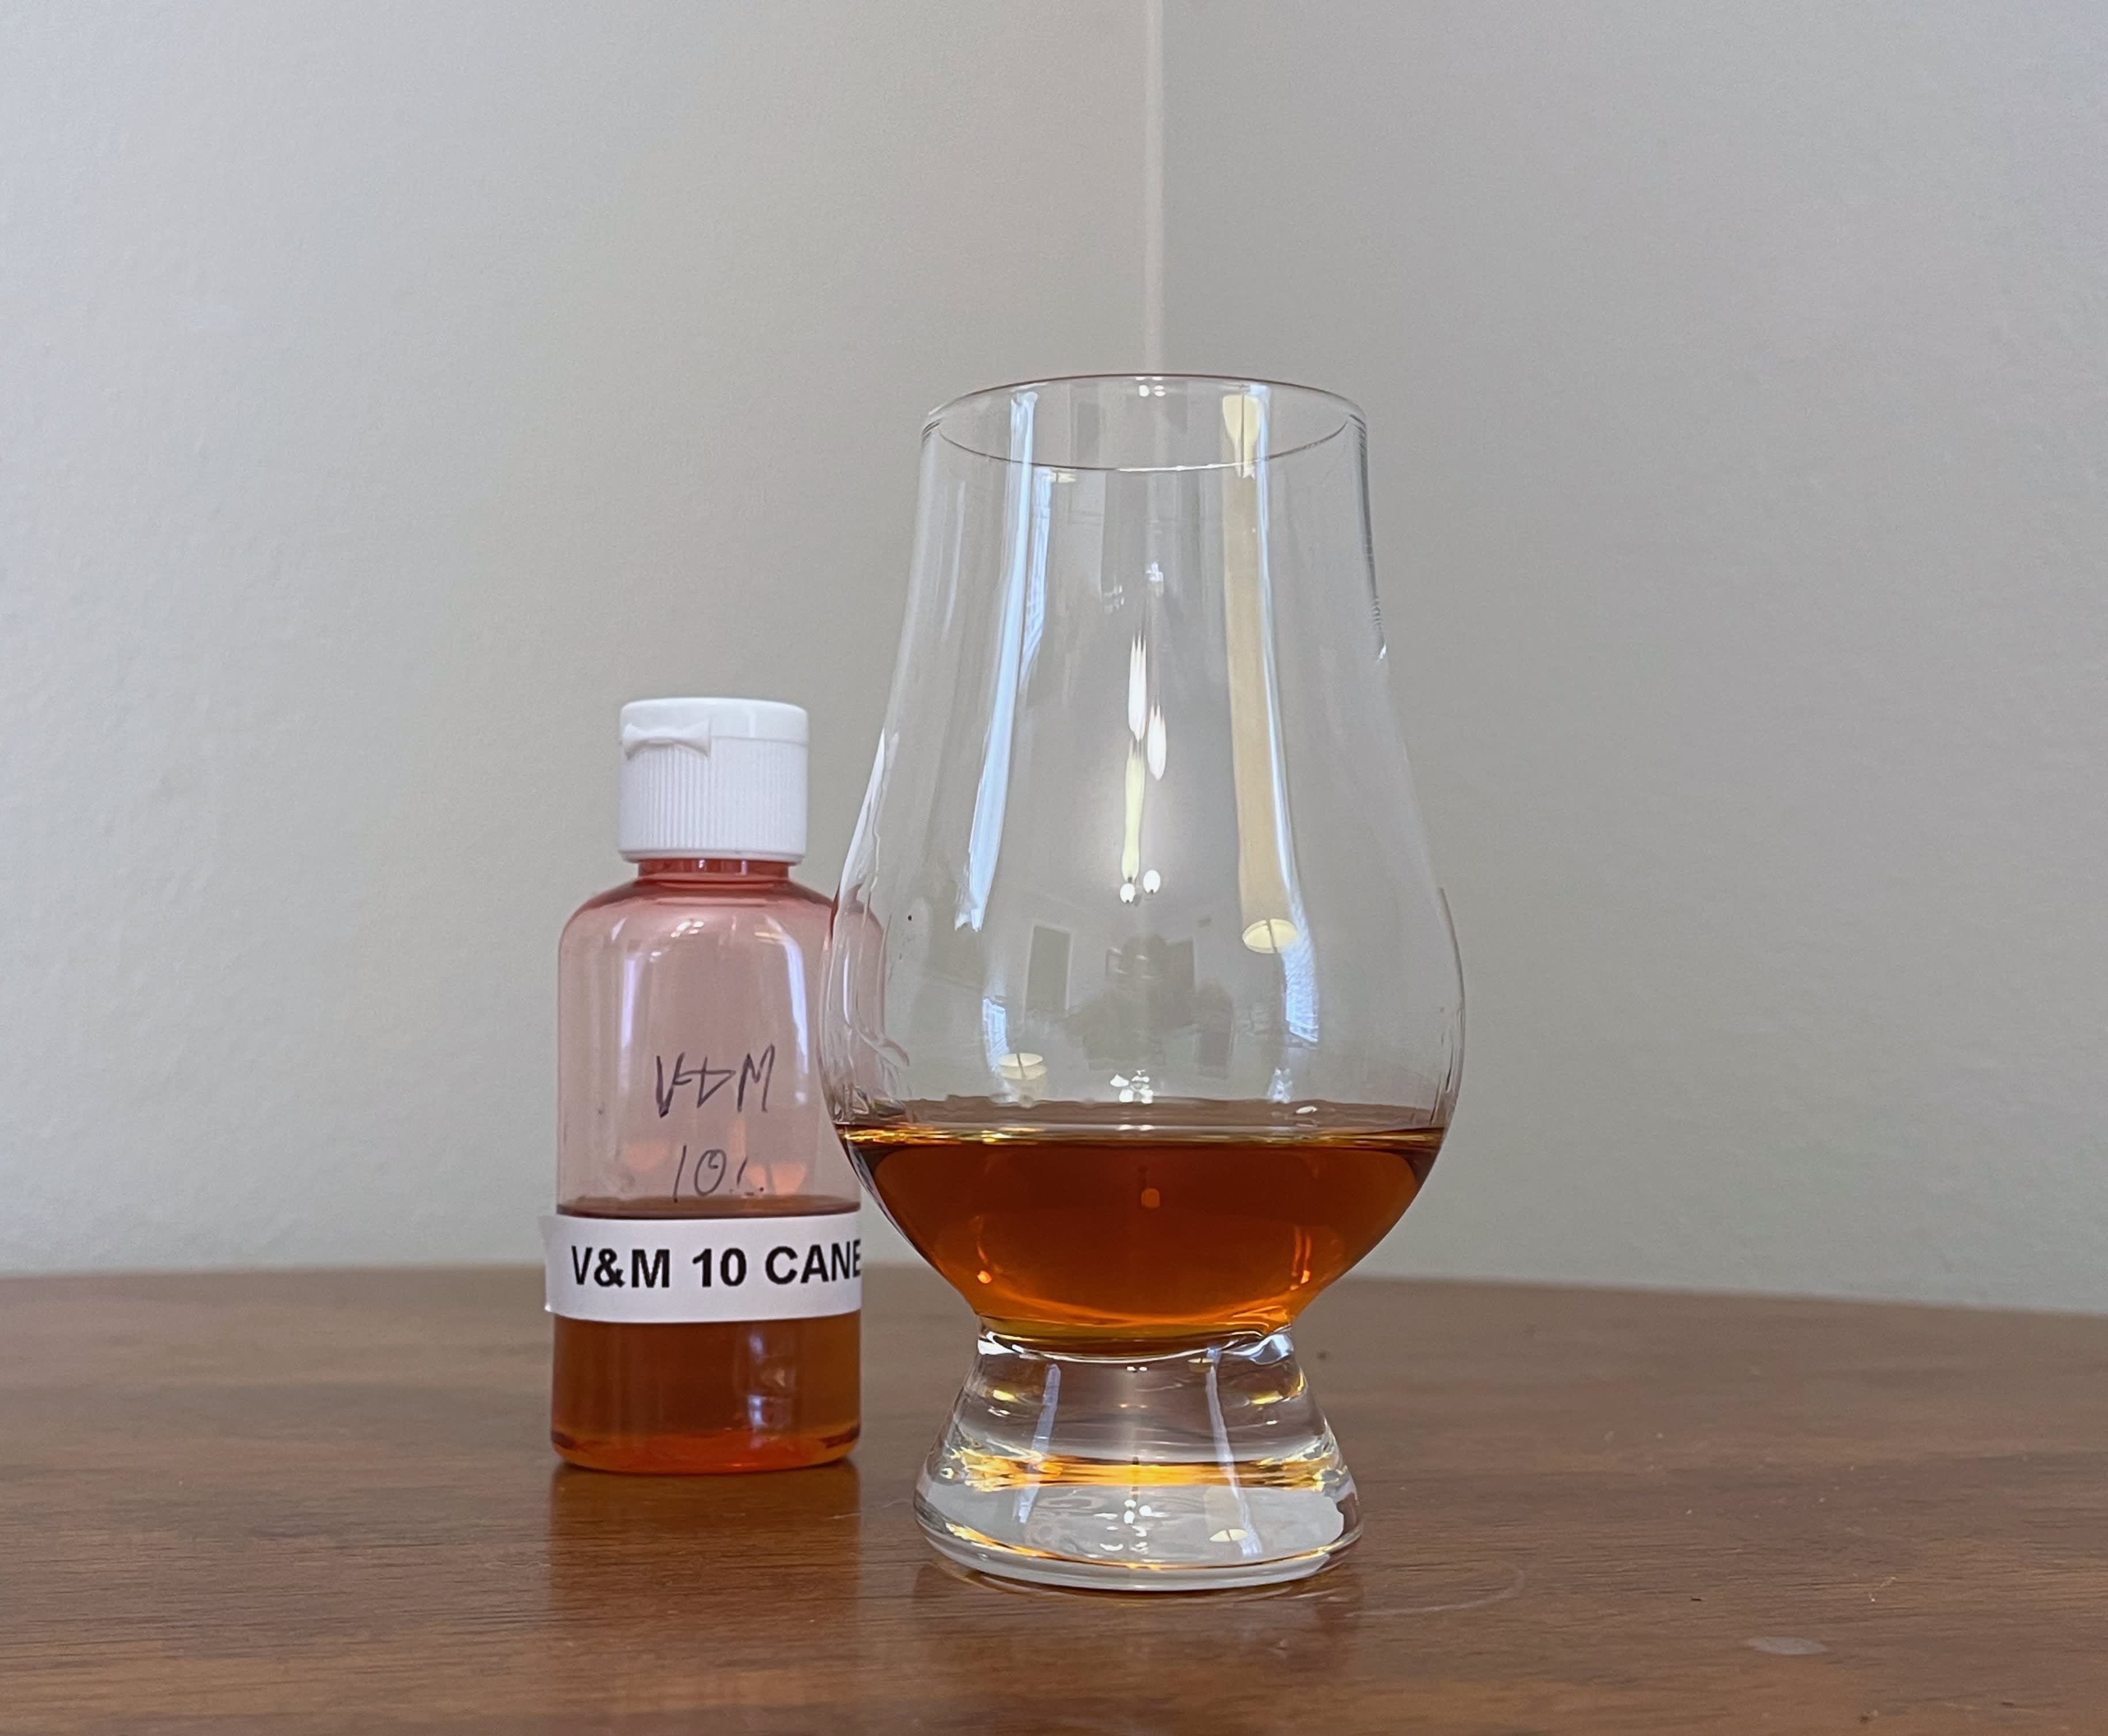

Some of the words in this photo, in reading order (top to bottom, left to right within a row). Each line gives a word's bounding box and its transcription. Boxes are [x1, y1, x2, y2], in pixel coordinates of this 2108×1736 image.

[571, 1245, 671, 1288] V&M
[692, 1247, 747, 1288] 10
[765, 1238, 861, 1285] CANE
